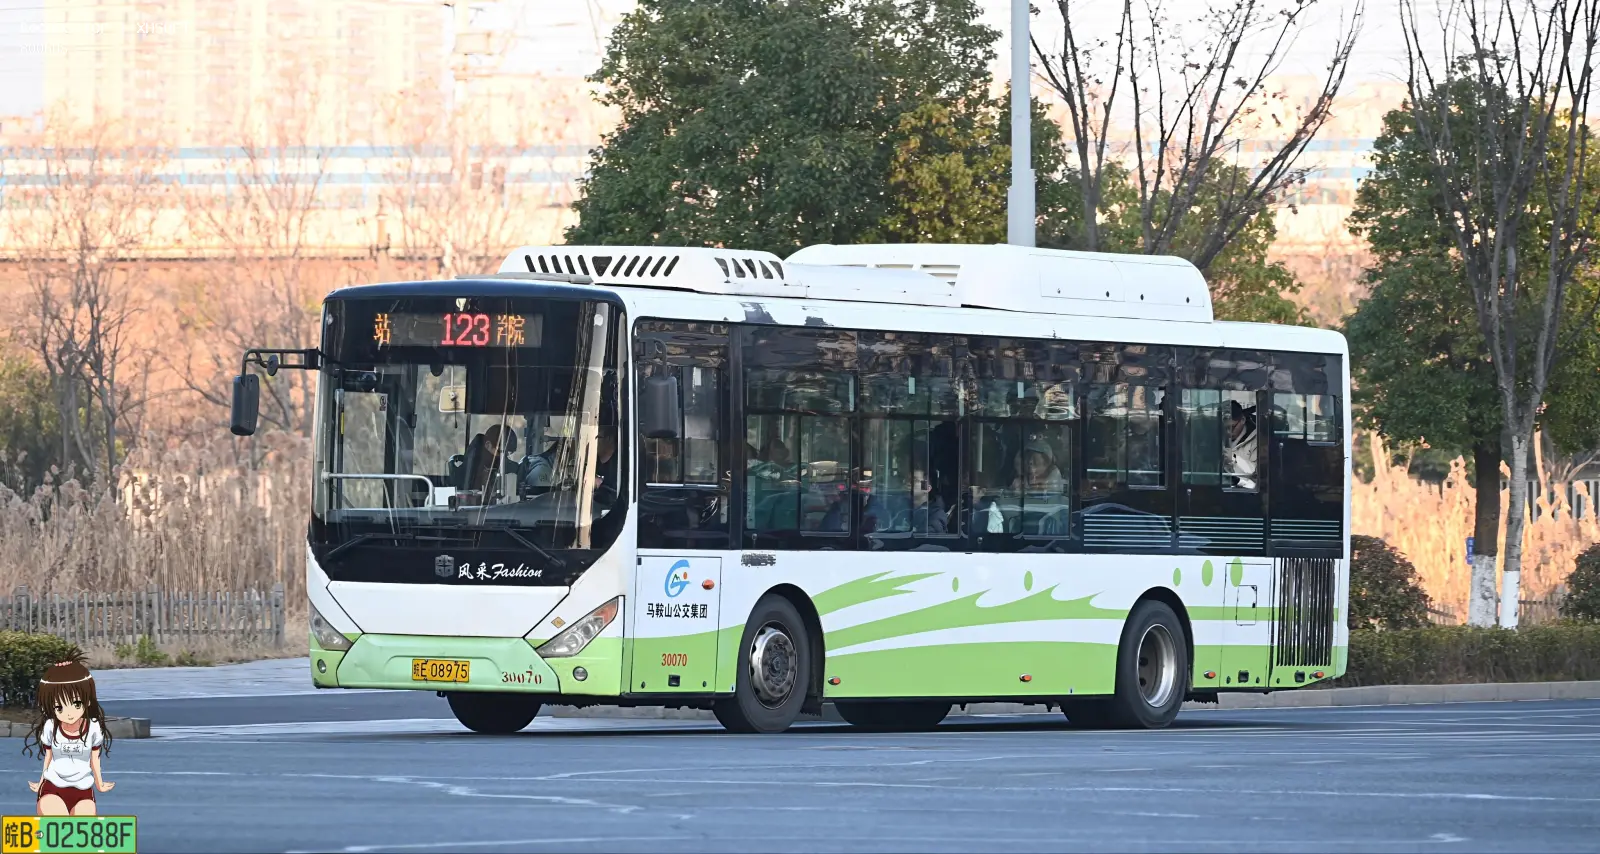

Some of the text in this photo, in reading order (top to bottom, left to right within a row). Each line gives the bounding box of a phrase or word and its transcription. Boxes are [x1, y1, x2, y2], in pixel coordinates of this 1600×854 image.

[440, 313, 491, 345] 123
[458, 562, 543, 581] 风采 Fashion
[647, 603, 708, 619] 马鞍山公交集团
[661, 653, 688, 667] 30070
[502, 671, 542, 685] 30070
